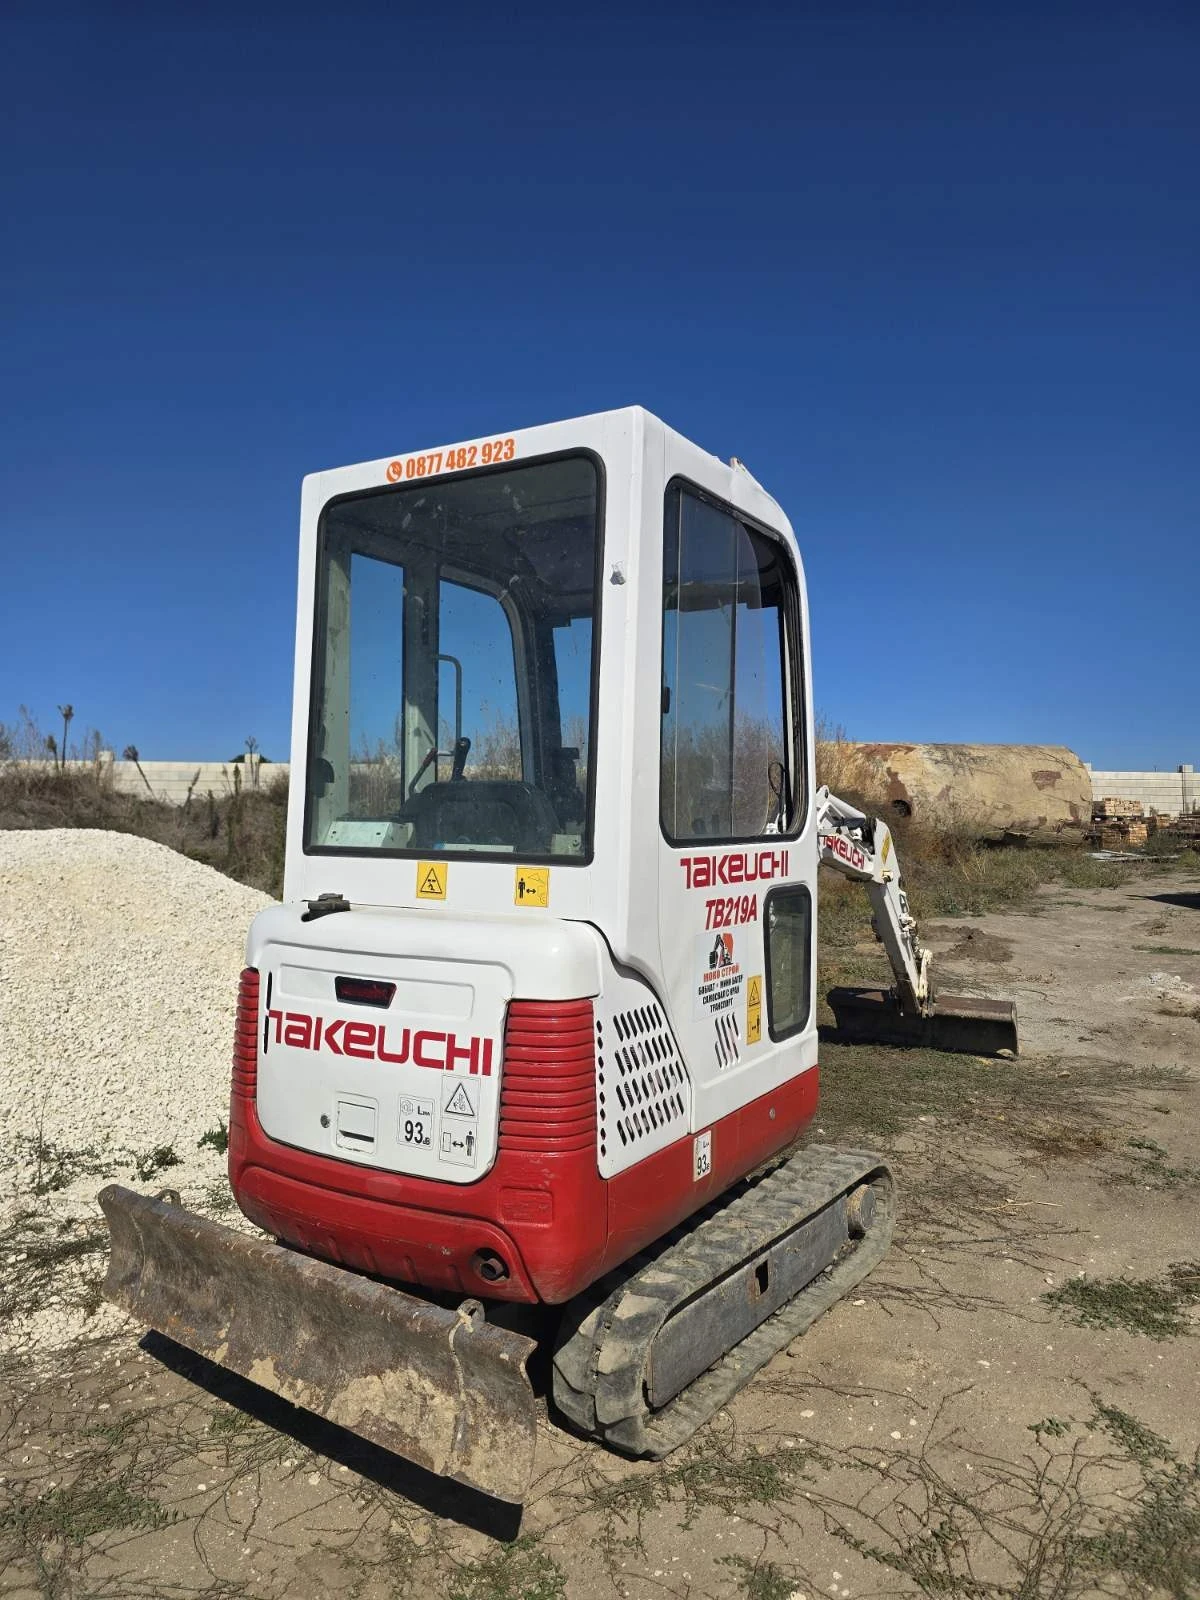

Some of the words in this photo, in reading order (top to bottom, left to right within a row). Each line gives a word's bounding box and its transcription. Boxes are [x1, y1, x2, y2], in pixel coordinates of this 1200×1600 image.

[406, 453, 442, 479] 0877
[446, 445, 478, 470] 482
[481, 438, 515, 464] 923
[705, 894, 757, 930] TB219A
